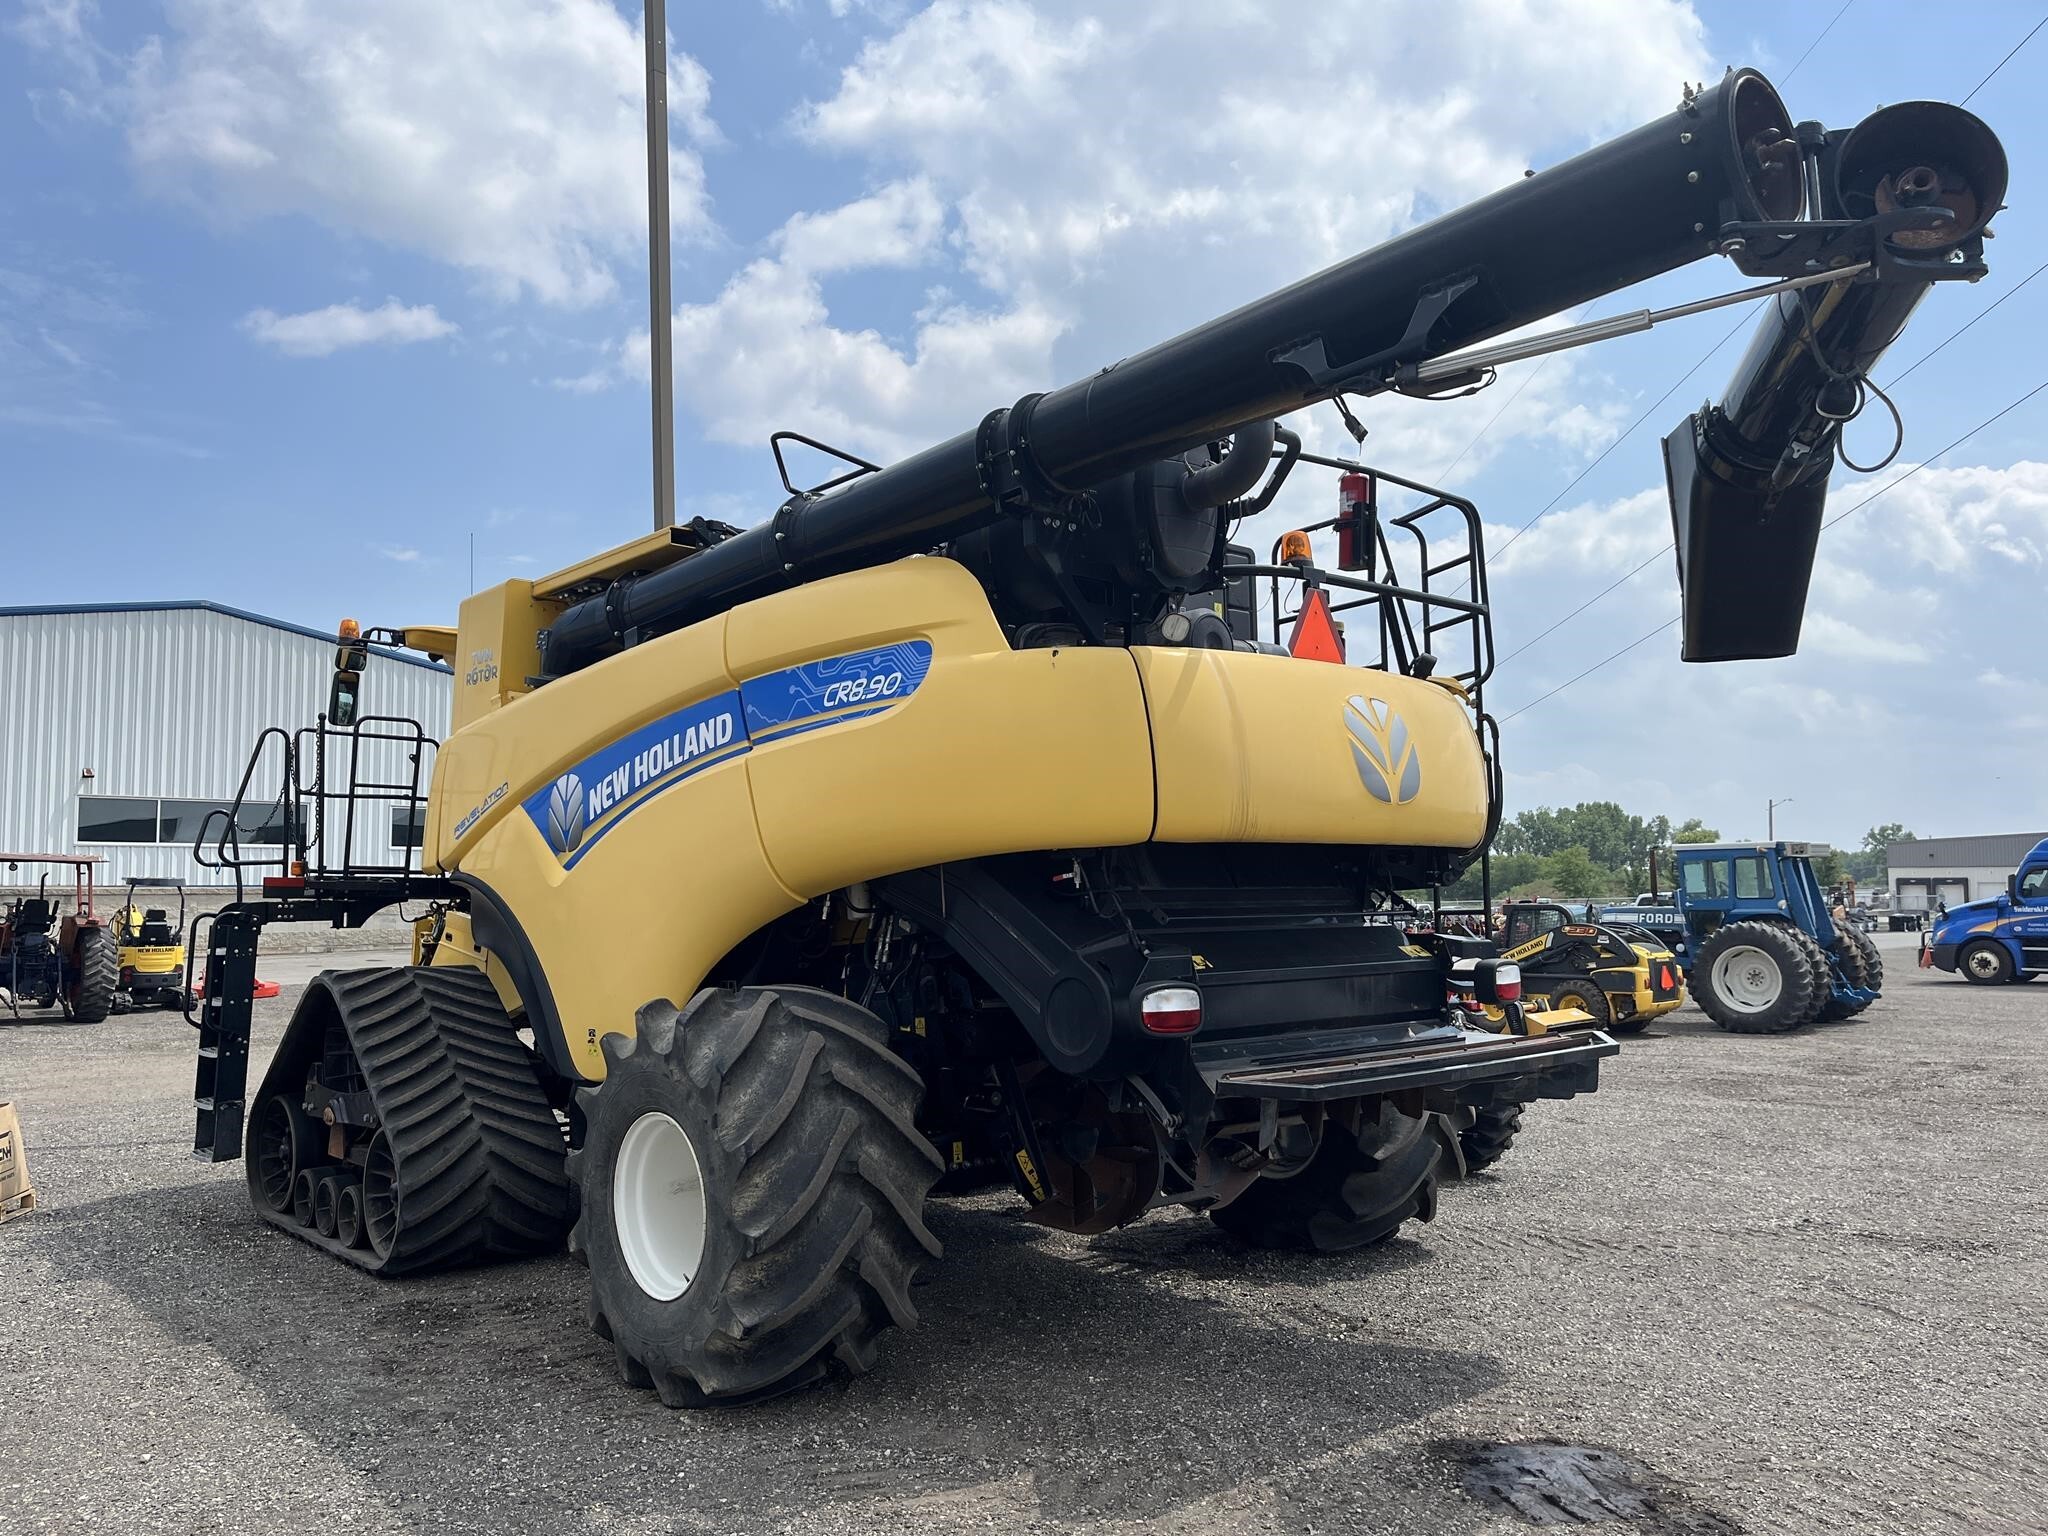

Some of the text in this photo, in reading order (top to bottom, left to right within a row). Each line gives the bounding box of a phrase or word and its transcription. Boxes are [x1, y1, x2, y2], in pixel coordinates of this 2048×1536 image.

[466, 664, 498, 686] ROTOR
[823, 672, 901, 707] CR8.90
[589, 713, 733, 821] NEW HOLLAND
[454, 781, 509, 838] REVELATION
[1639, 913, 1674, 924] FORD
[1515, 940, 1544, 957] HOLLAND
